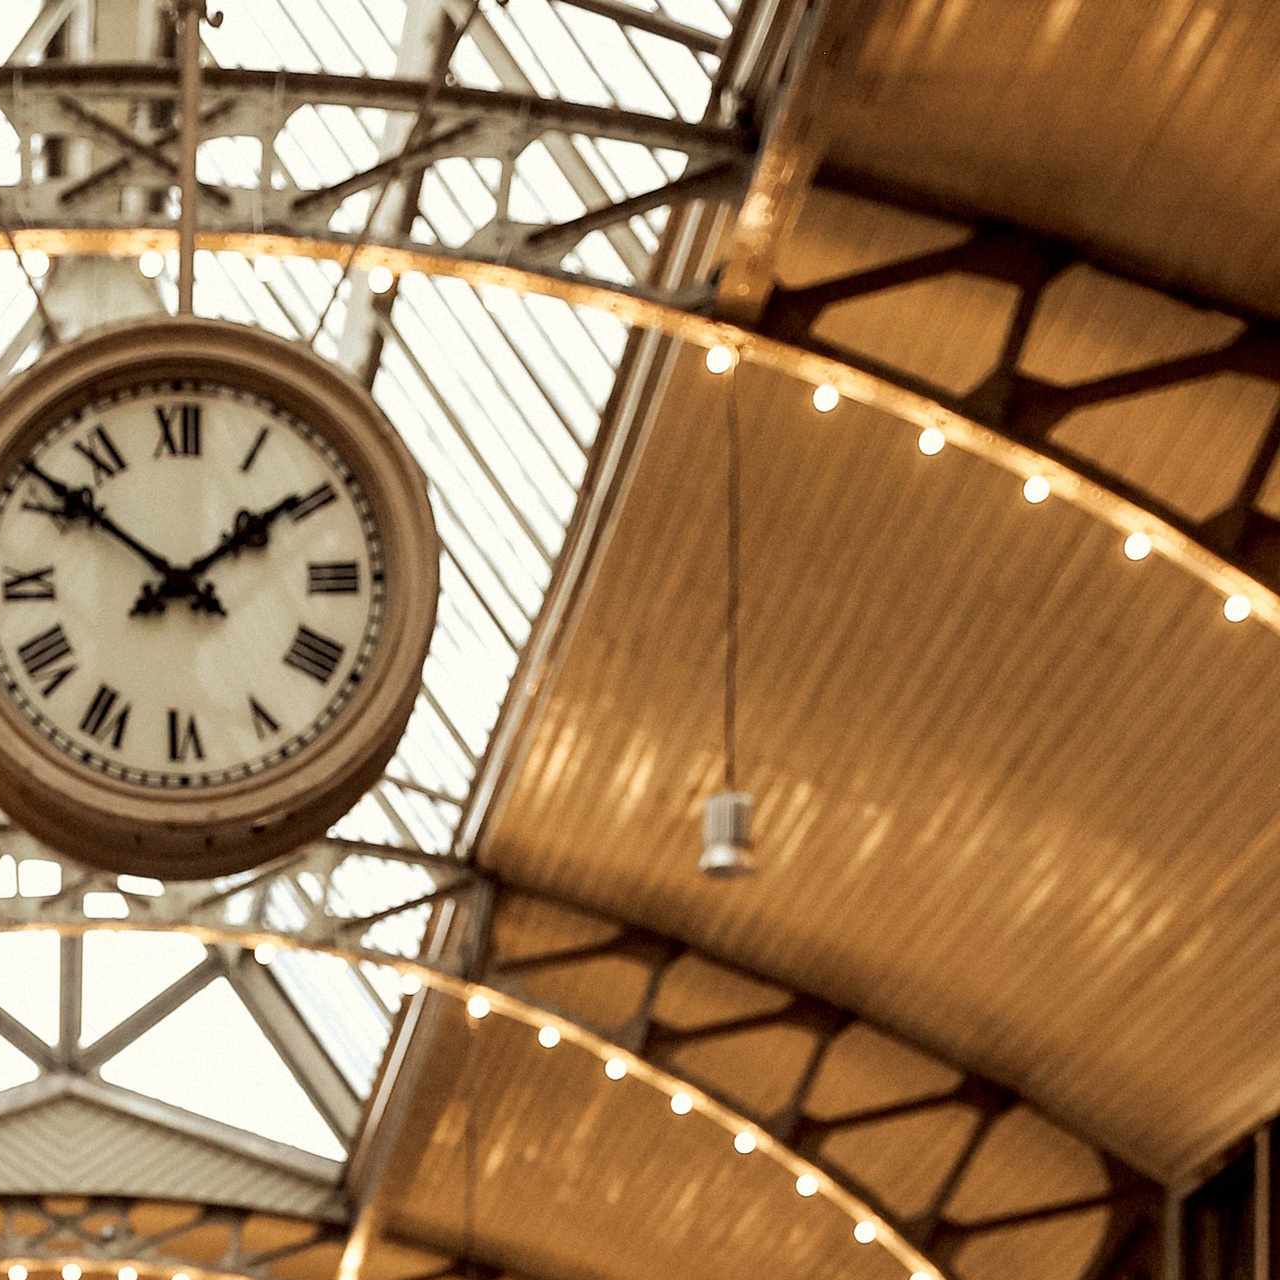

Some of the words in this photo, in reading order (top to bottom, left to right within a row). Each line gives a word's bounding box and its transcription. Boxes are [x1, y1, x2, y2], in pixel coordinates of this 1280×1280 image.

[74, 426, 127, 487] XI
[153, 404, 201, 459] XII
[242, 426, 269, 473] I
[290, 482, 336, 522] II
[3, 564, 55, 602] IX
[308, 560, 358, 595] III
[18, 622, 77, 698] VIII
[284, 622, 345, 684] IIII
[79, 683, 132, 750] VII
[167, 708, 205, 762] VI
[247, 694, 280, 741] V
